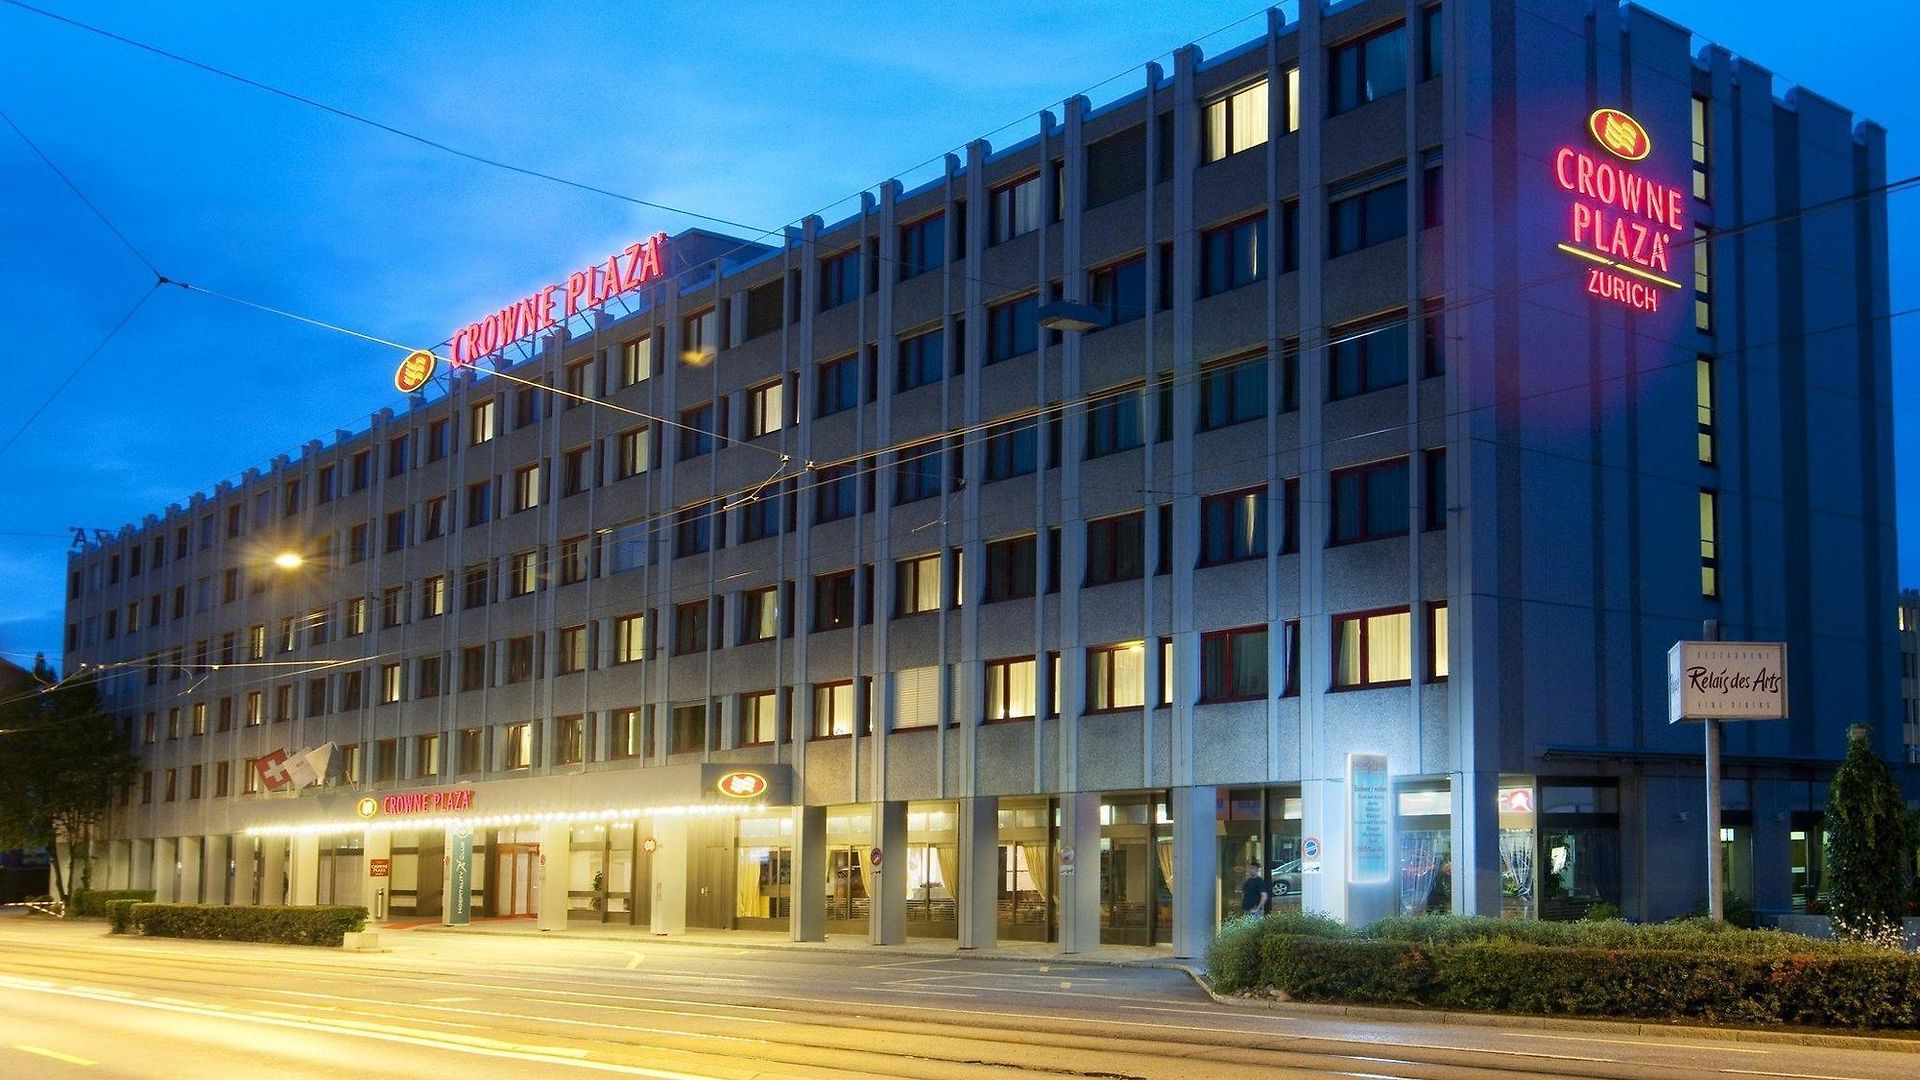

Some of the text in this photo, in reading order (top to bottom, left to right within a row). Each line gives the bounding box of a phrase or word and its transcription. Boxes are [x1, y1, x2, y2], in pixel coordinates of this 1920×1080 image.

[1556, 147, 1683, 231] CROWNE
[1573, 201, 1669, 272] PLAZA
[450, 232, 667, 369] CROWNE PLAZA
[1588, 269, 1658, 312] ZURICH
[1730, 672, 1751, 689] des
[1752, 667, 1782, 694] Arts
[383, 789, 471, 816] CROWNE PLAZA
